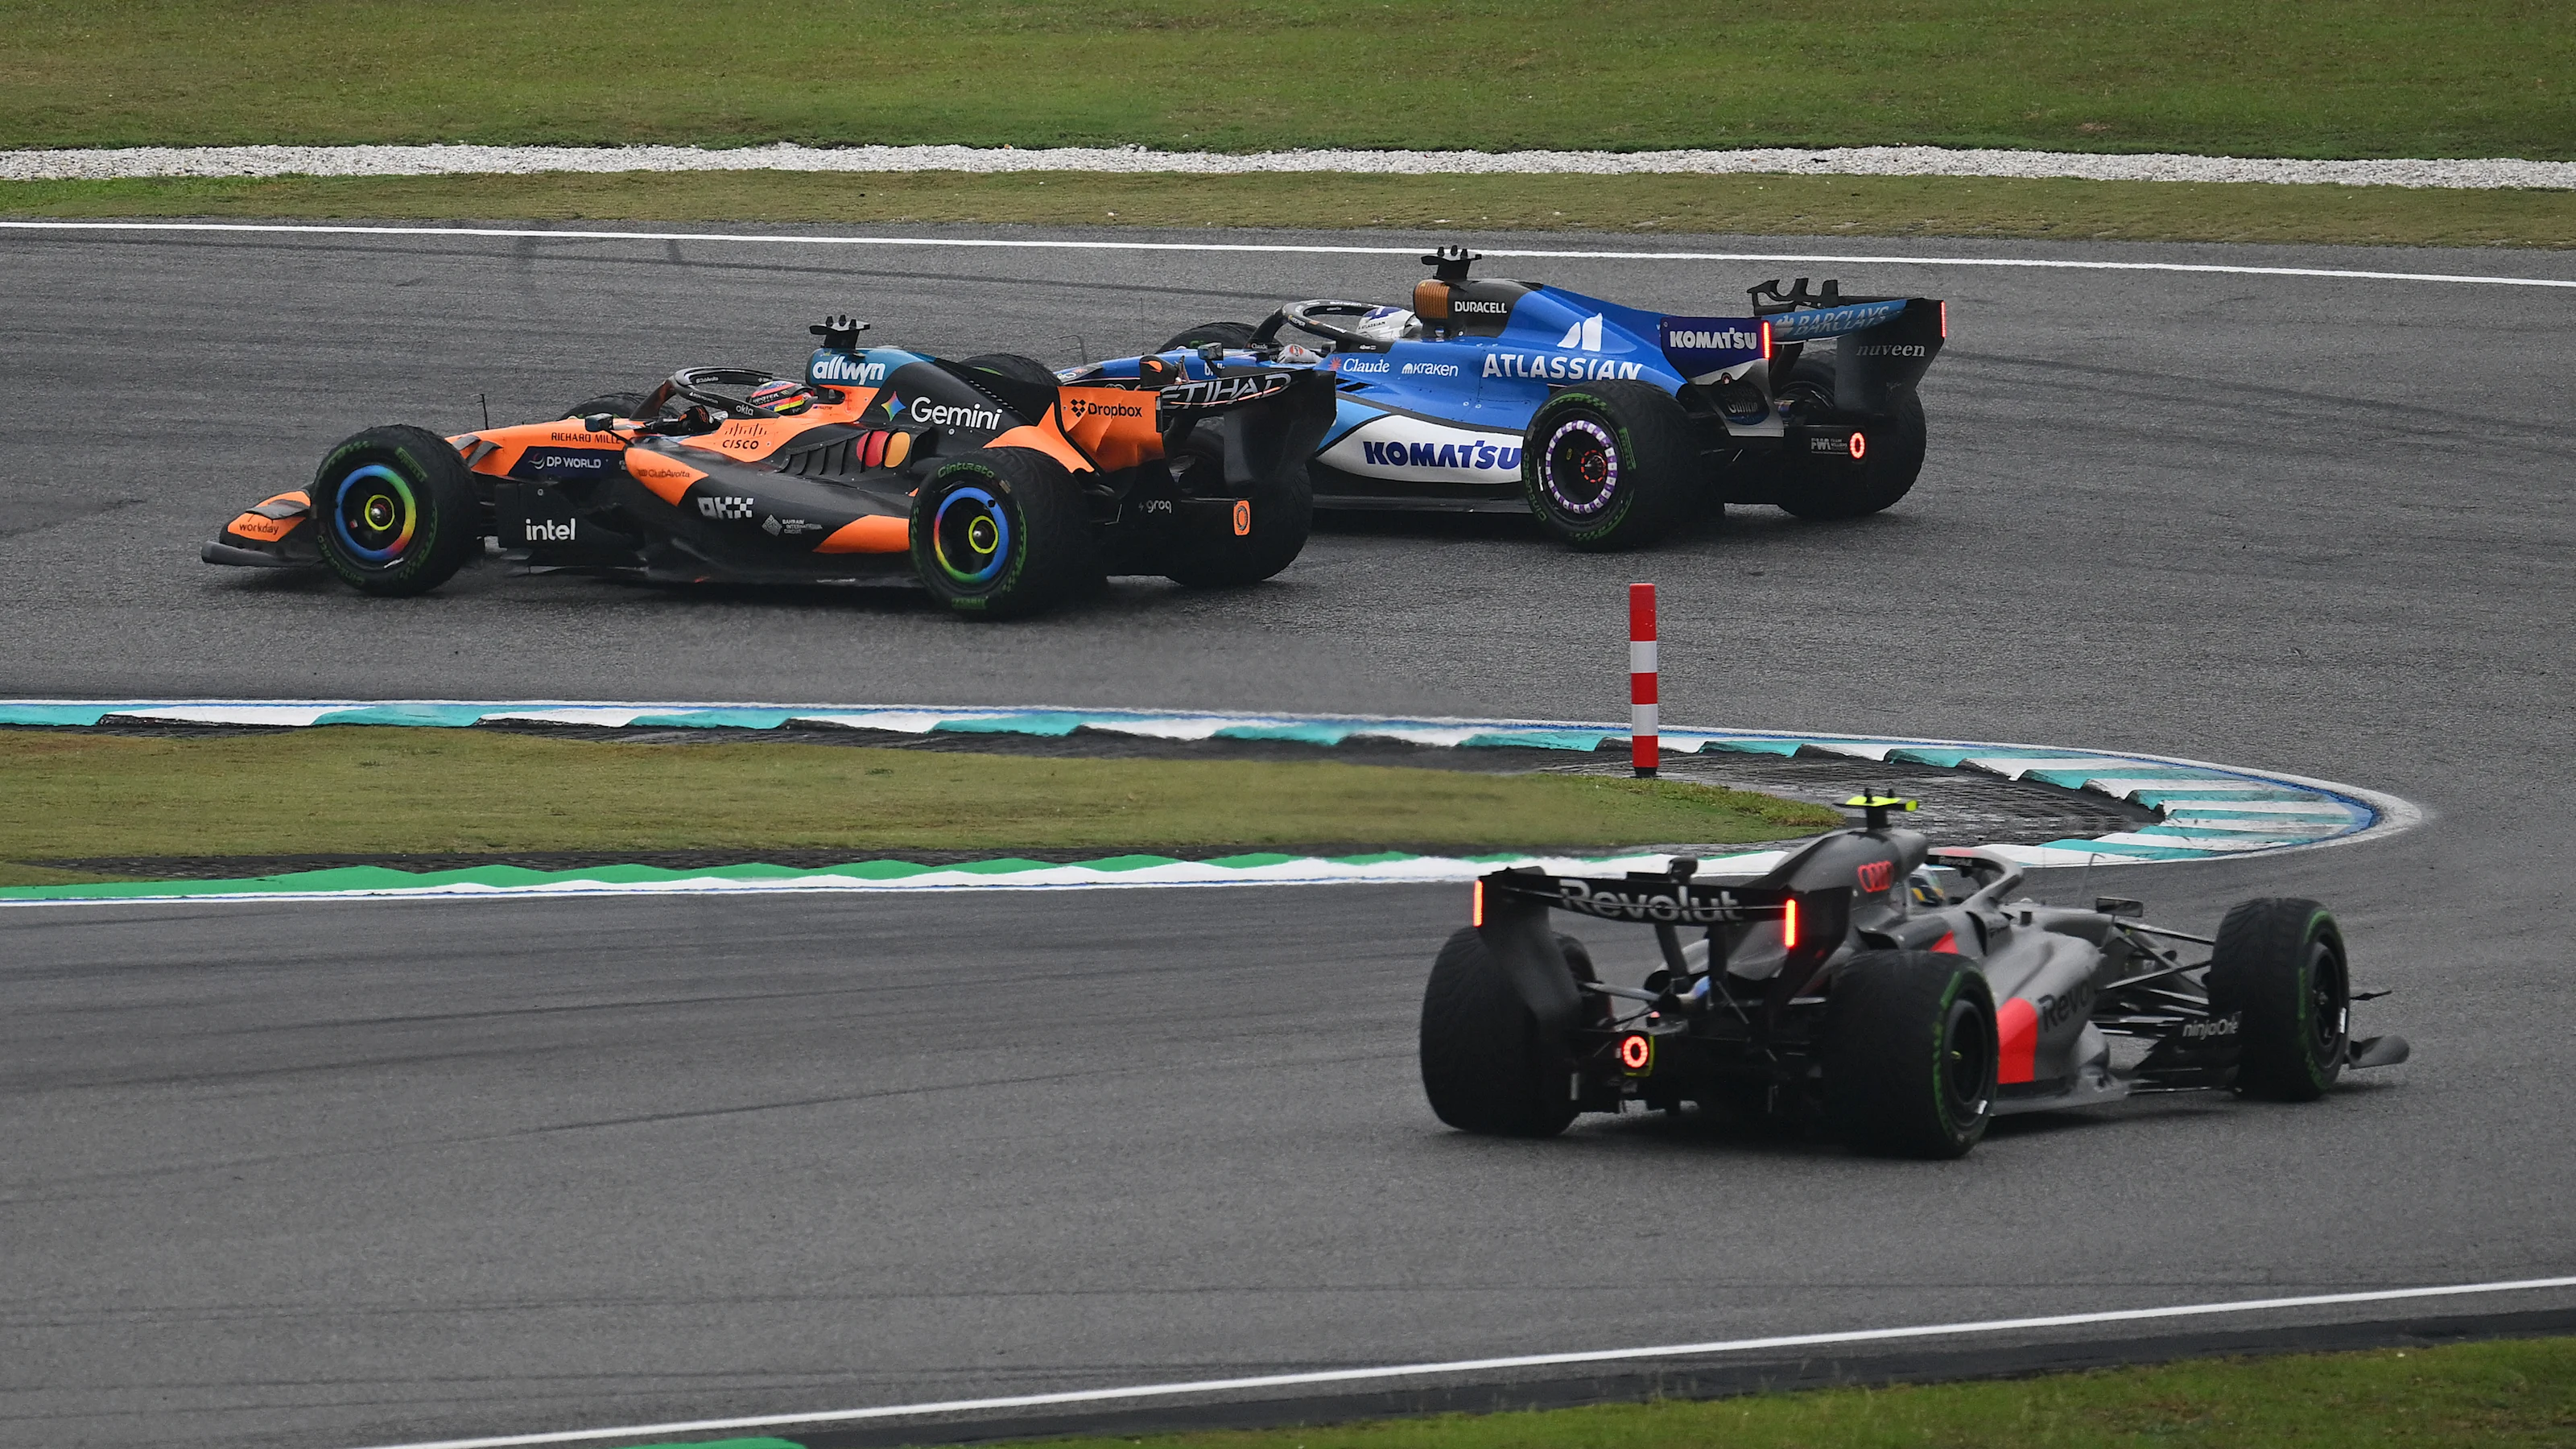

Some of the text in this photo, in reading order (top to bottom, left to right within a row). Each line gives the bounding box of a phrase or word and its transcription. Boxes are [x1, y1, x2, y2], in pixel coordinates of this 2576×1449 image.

[1455, 301, 1507, 313] DURACELL
[1794, 306, 1889, 336] BARCLAYS
[1670, 327, 1757, 349] KOMATSU
[1856, 345, 1926, 357] nuveen
[812, 357, 886, 385] allwyn
[1343, 357, 1390, 373] Claude
[1481, 353, 1642, 381] ATLASSIAN
[1161, 374, 1291, 410] ETIHAD
[735, 404, 754, 416] okta
[910, 397, 1003, 430] Gemini
[1088, 402, 1142, 418] Dropbox
[551, 432, 592, 443] RICHARD
[722, 440, 759, 449] CISCO
[547, 456, 601, 469] DP WORLD
[1363, 440, 1521, 469] KOMATSU
[697, 497, 754, 519] OKX
[1146, 500, 1172, 514] groq
[239, 523, 279, 535] workday
[526, 518, 576, 541] intel
[1558, 879, 1744, 922] Revolut
